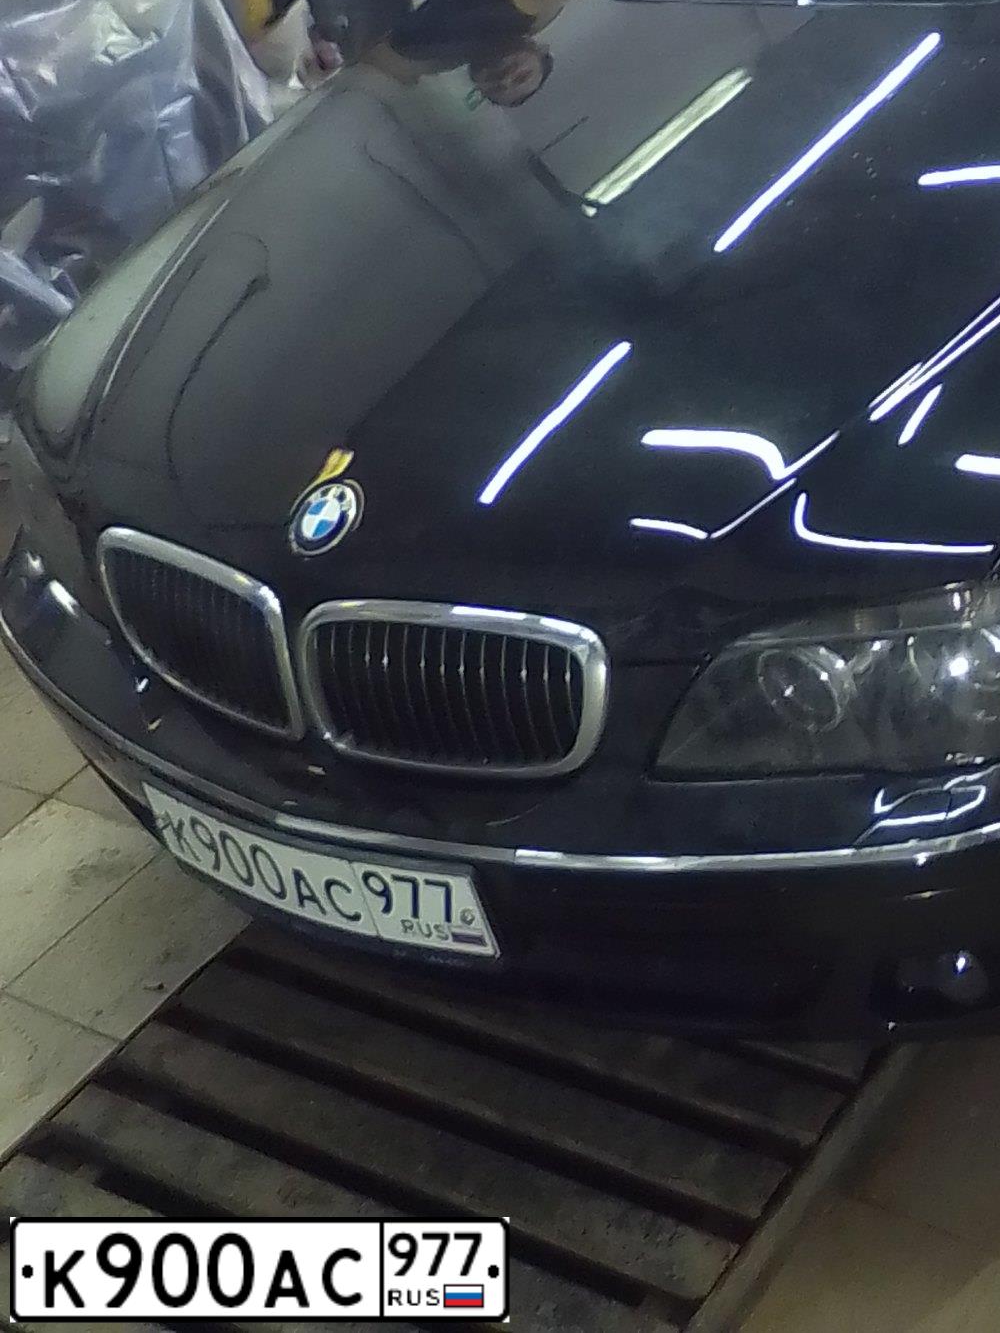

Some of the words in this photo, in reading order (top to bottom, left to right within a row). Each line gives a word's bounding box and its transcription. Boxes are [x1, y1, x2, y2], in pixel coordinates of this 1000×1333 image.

[164, 809, 362, 922] K900AC
[361, 870, 453, 924] 977
[401, 918, 450, 942] RUS
